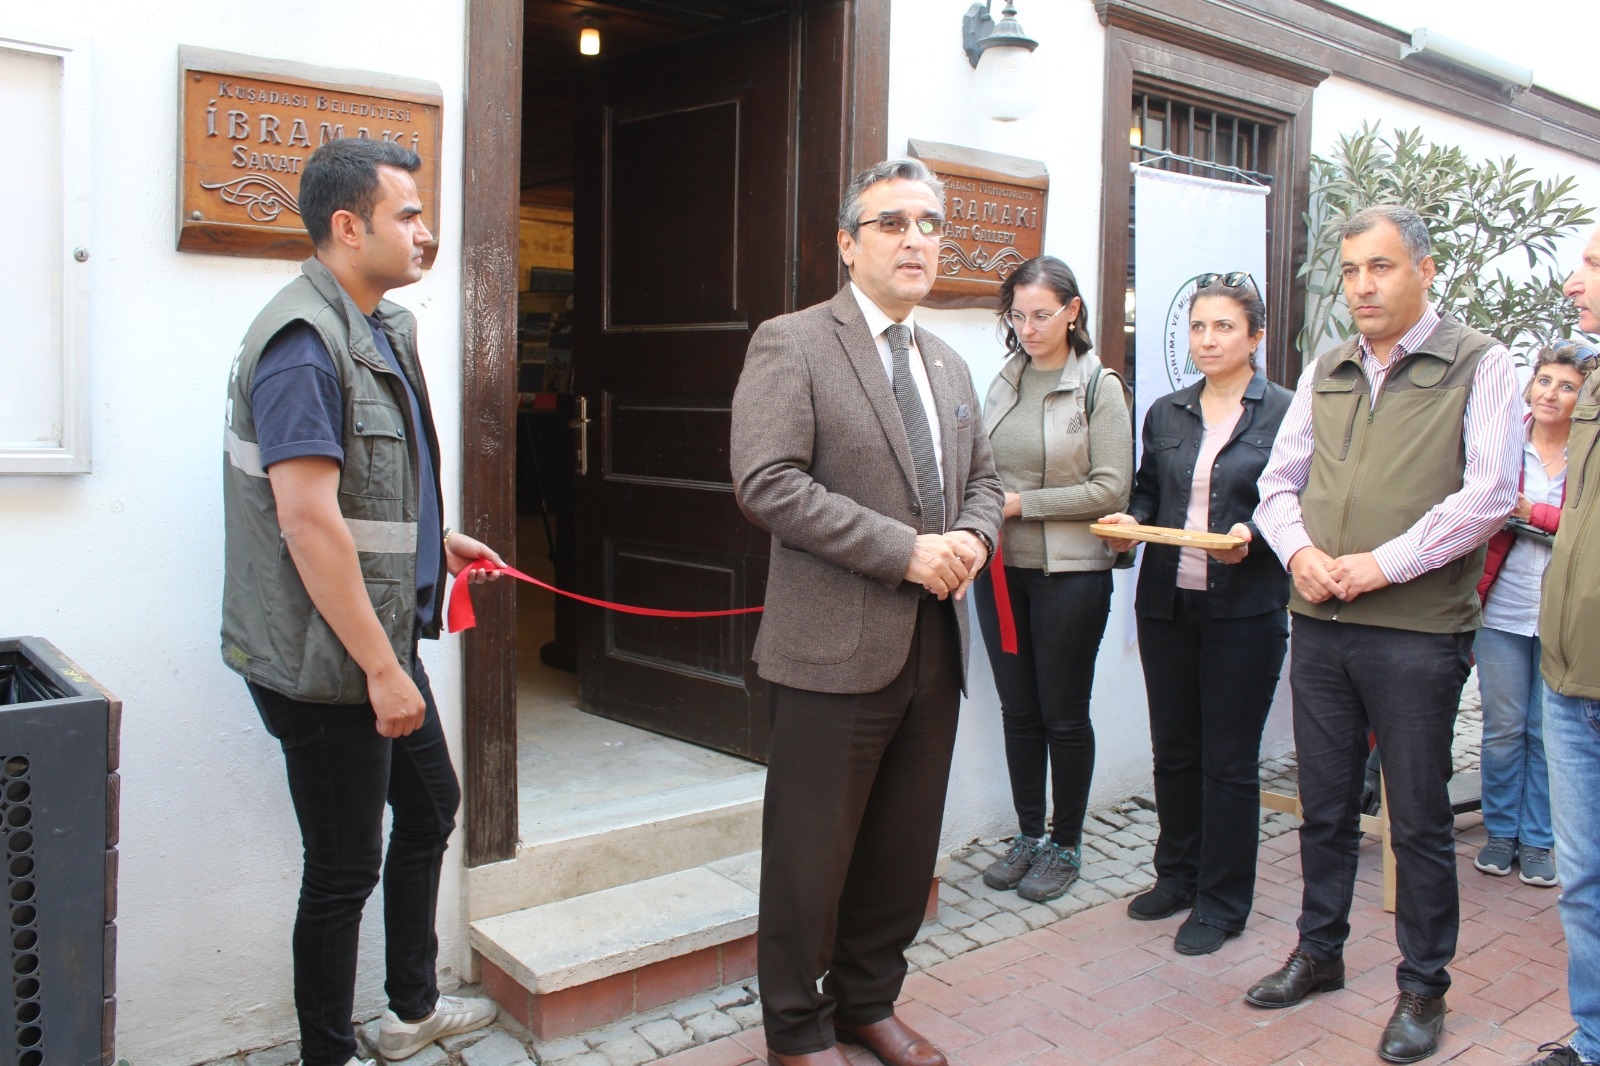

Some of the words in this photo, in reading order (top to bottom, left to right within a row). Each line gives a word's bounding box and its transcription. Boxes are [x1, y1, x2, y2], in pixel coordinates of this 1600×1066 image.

[218, 80, 308, 109] KUŞADASI
[231, 144, 302, 174] SANAT
[944, 220, 970, 240] ART
[971, 224, 1017, 245] GALLERY
[1172, 312, 1180, 327] VE
[1169, 331, 1182, 384] KORUMA
